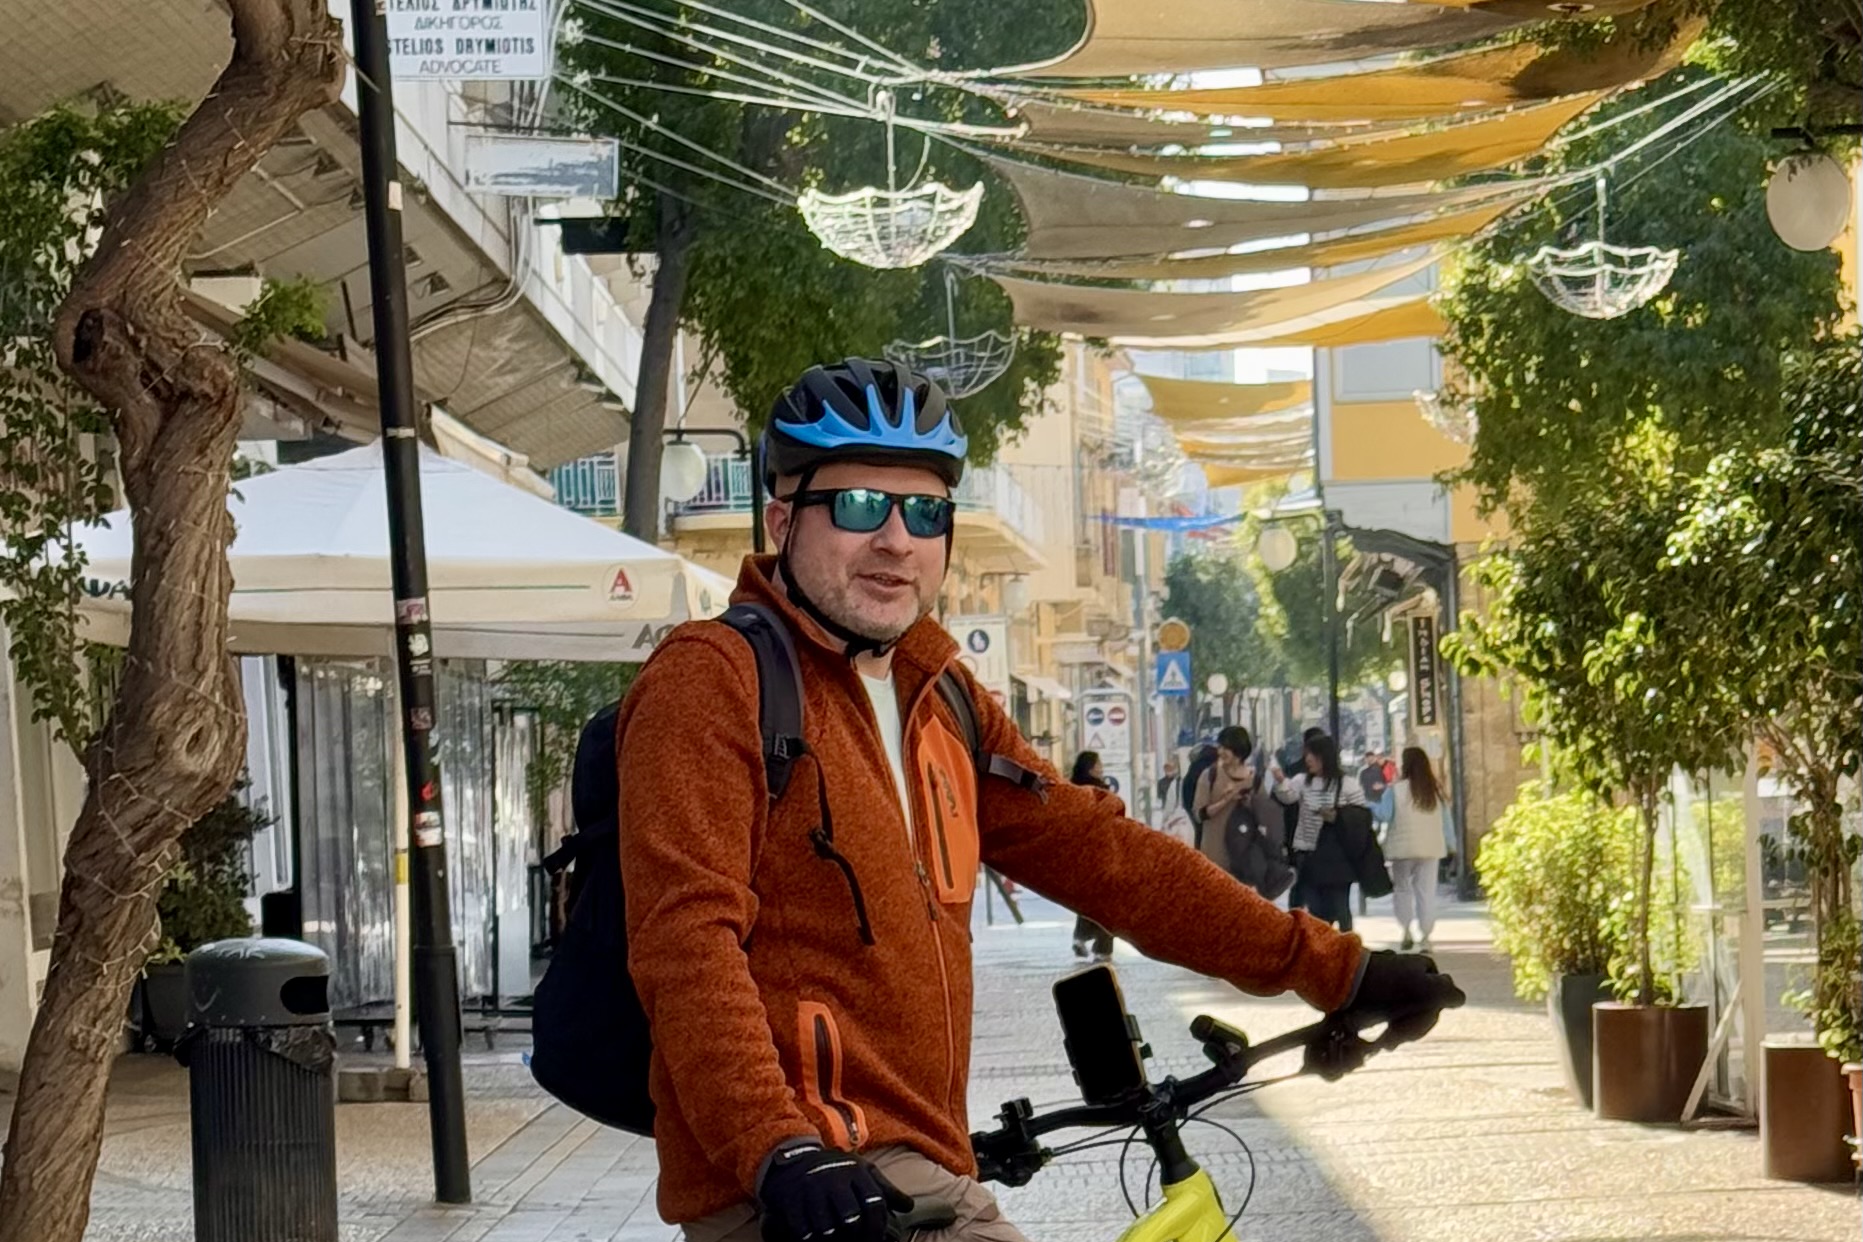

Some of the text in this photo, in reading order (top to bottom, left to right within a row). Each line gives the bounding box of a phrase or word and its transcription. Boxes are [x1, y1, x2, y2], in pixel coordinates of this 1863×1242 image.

[387, 0, 440, 11] ΤΕΛΙΟΣ
[414, 16, 503, 30] ΔΙΚΗΓΟΡΟΣ
[387, 37, 535, 55] TELIOS DRYMIOTIS
[419, 59, 502, 74] ADVOCATE
